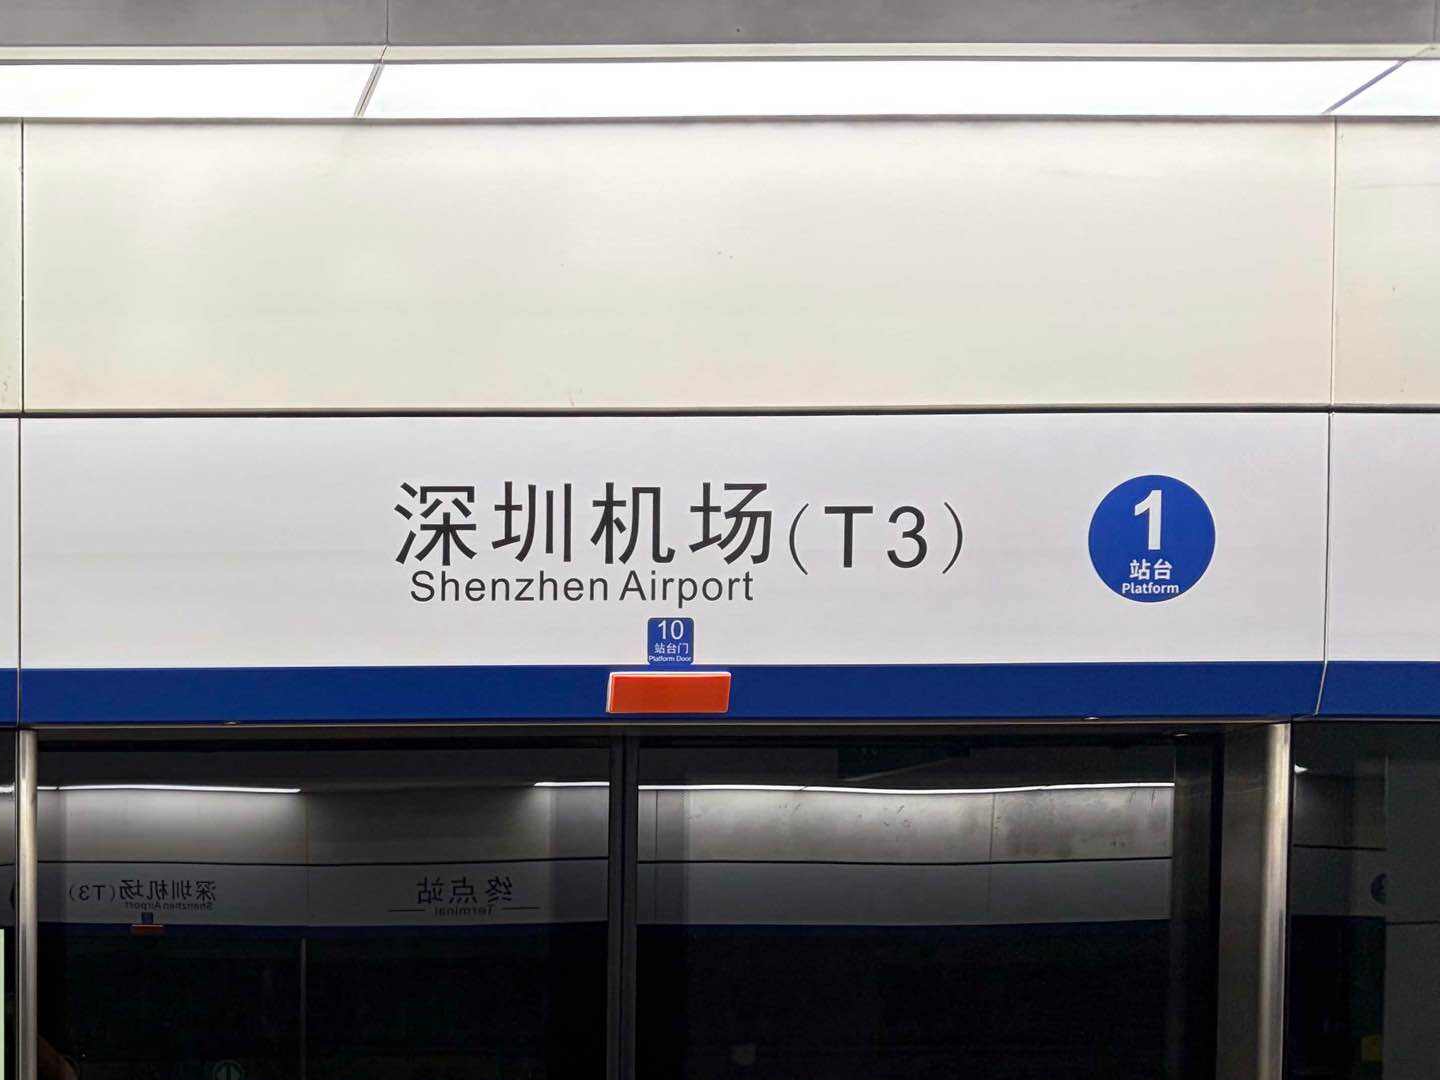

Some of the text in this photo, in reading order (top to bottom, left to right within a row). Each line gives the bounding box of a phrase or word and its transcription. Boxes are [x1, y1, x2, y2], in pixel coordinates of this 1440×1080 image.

[1135, 490, 1161, 550] 1
[1130, 559, 1172, 580] 站台
[411, 570, 753, 608] Shenzhen Airport
[1122, 583, 1179, 594] Platform
[659, 620, 683, 639] 10
[655, 643, 688, 654] 站台门
